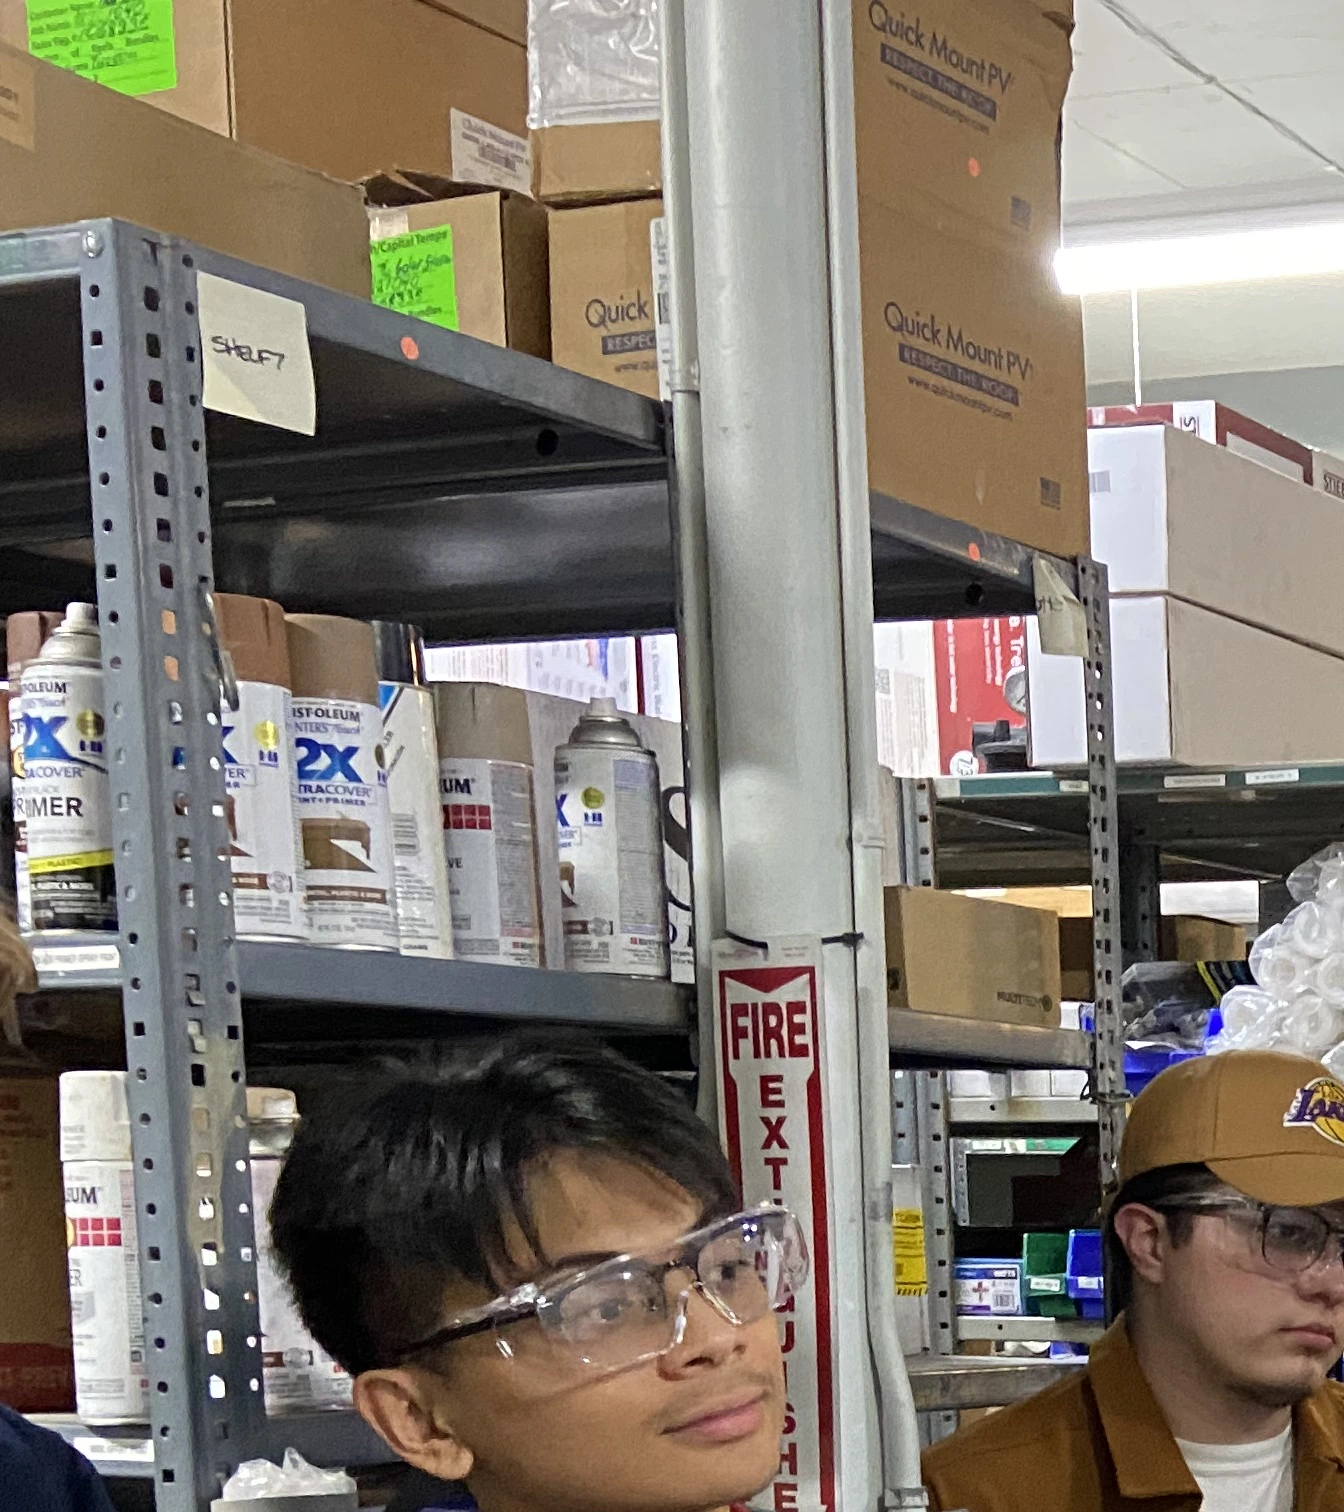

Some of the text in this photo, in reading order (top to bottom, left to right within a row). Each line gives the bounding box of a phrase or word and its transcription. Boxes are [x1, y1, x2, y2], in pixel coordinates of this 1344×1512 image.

[868, 0, 925, 51] Quick
[929, 28, 985, 84] Mount
[585, 288, 649, 331] Quick
[606, 334, 656, 351] RESPEC
[884, 301, 942, 347] Quick
[946, 323, 1002, 371] Mount
[294, 737, 363, 783] 2X
[730, 1001, 810, 1060] FIRE
